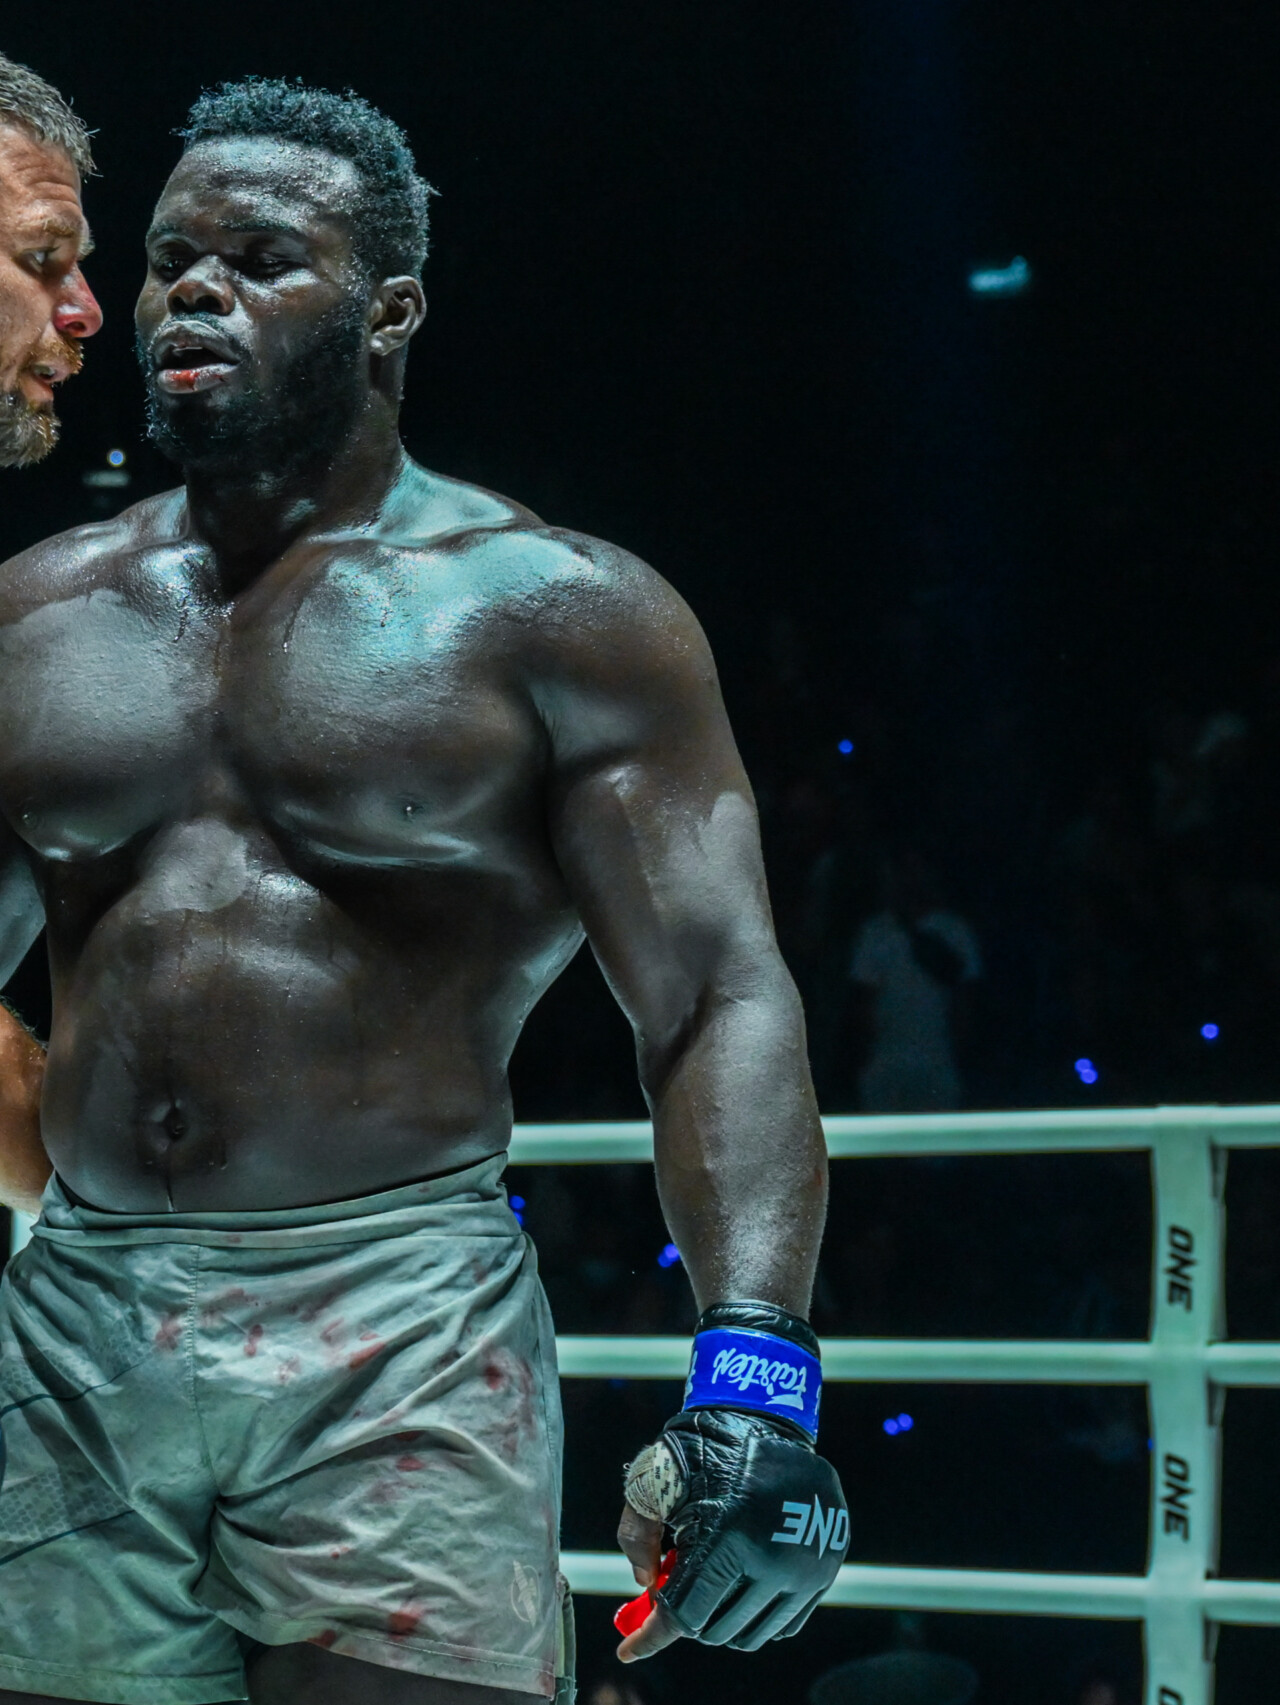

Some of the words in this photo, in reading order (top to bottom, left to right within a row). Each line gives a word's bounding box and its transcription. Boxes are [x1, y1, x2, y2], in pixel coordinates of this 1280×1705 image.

[1163, 1224, 1198, 1314] ONE
[710, 1347, 807, 1412] Fairtex
[770, 1493, 850, 1561] ONE
[1160, 1453, 1194, 1543] ONE
